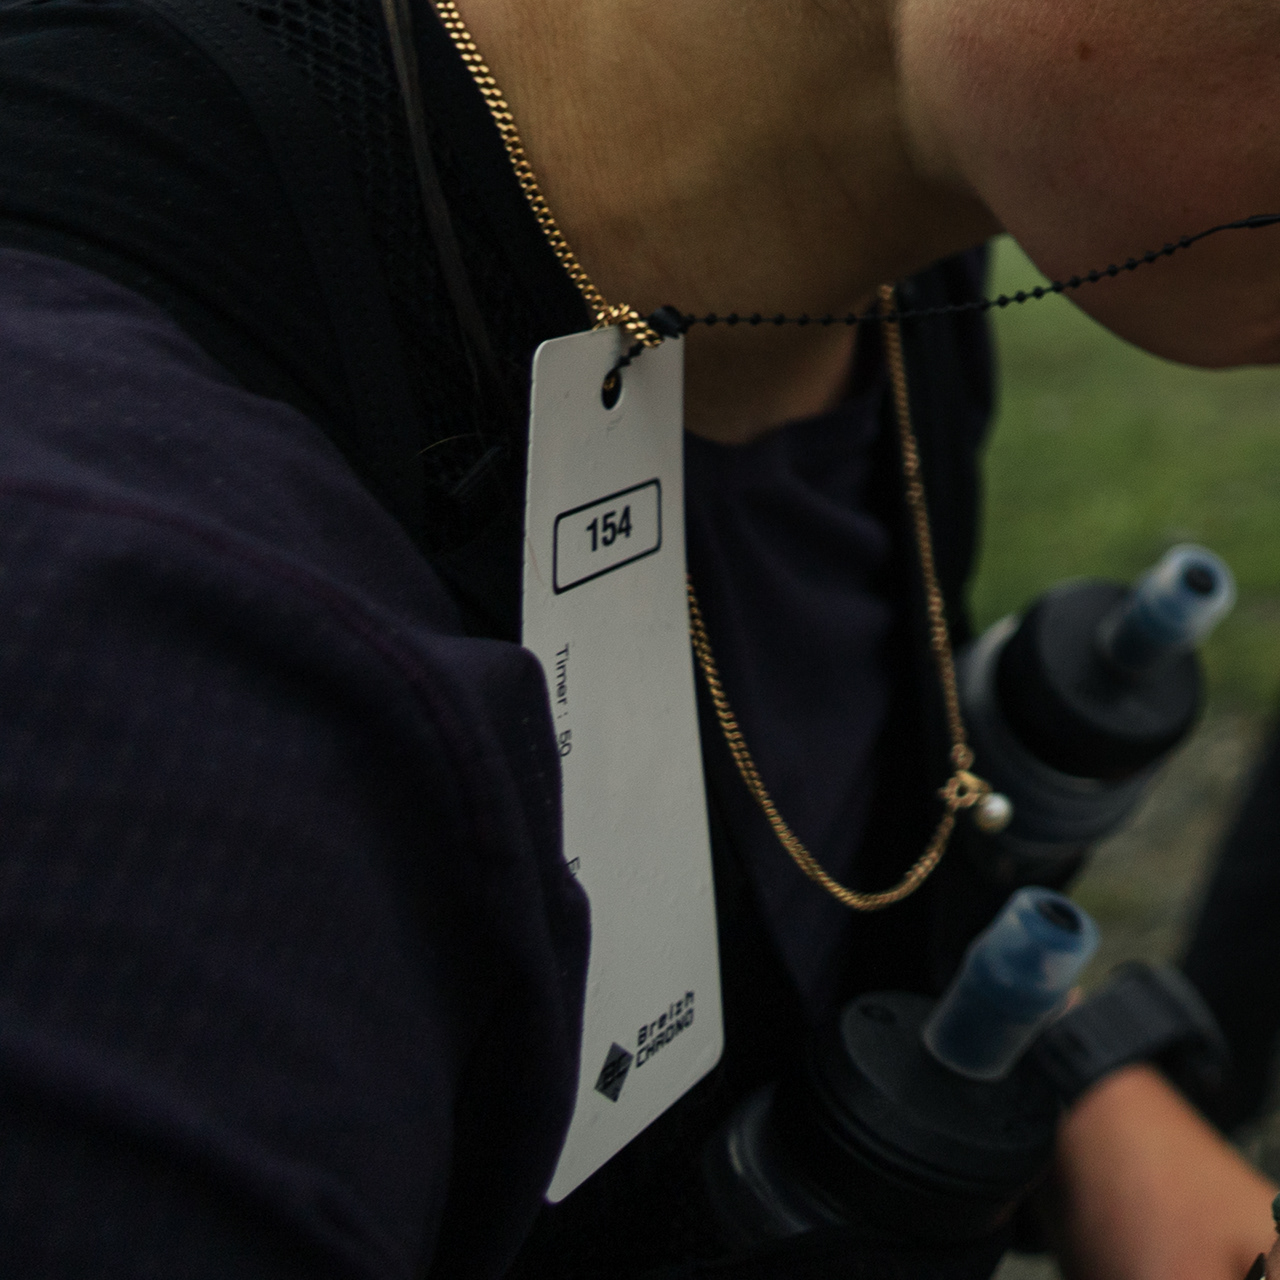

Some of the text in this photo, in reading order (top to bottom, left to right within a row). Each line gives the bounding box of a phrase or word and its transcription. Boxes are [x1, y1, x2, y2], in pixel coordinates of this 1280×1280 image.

[586, 505, 632, 552] 154
[556, 643, 569, 705] Timer
[636, 1008, 694, 1068] CHRONO
[637, 991, 694, 1047] Breizh
